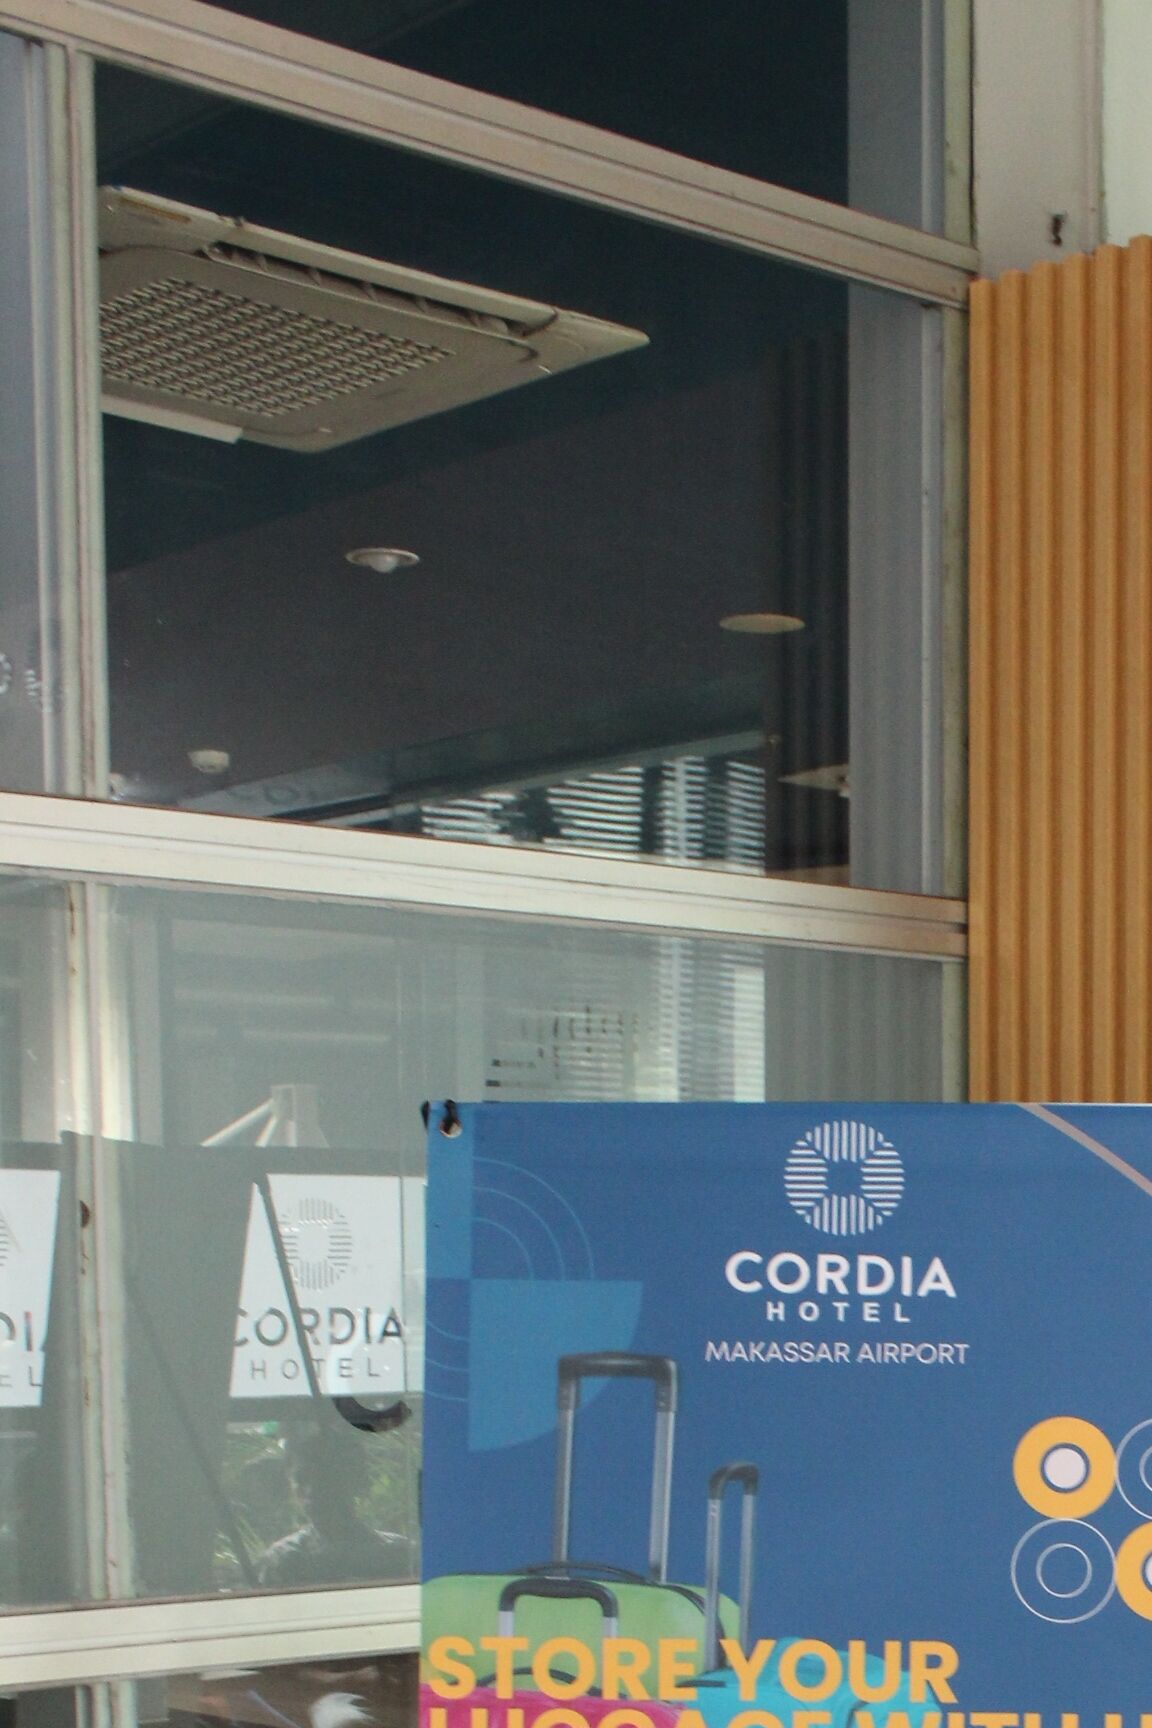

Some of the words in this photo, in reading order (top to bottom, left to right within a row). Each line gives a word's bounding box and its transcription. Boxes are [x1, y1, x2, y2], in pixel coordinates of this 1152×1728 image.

[724, 1250, 957, 1298] CORDIA
[766, 1301, 911, 1323] HOTEL
[705, 1341, 850, 1363] MAKASSAR
[857, 1342, 970, 1364] AIRPORT
[426, 1634, 699, 1701] STORE
[720, 1637, 957, 1702] YOUR
